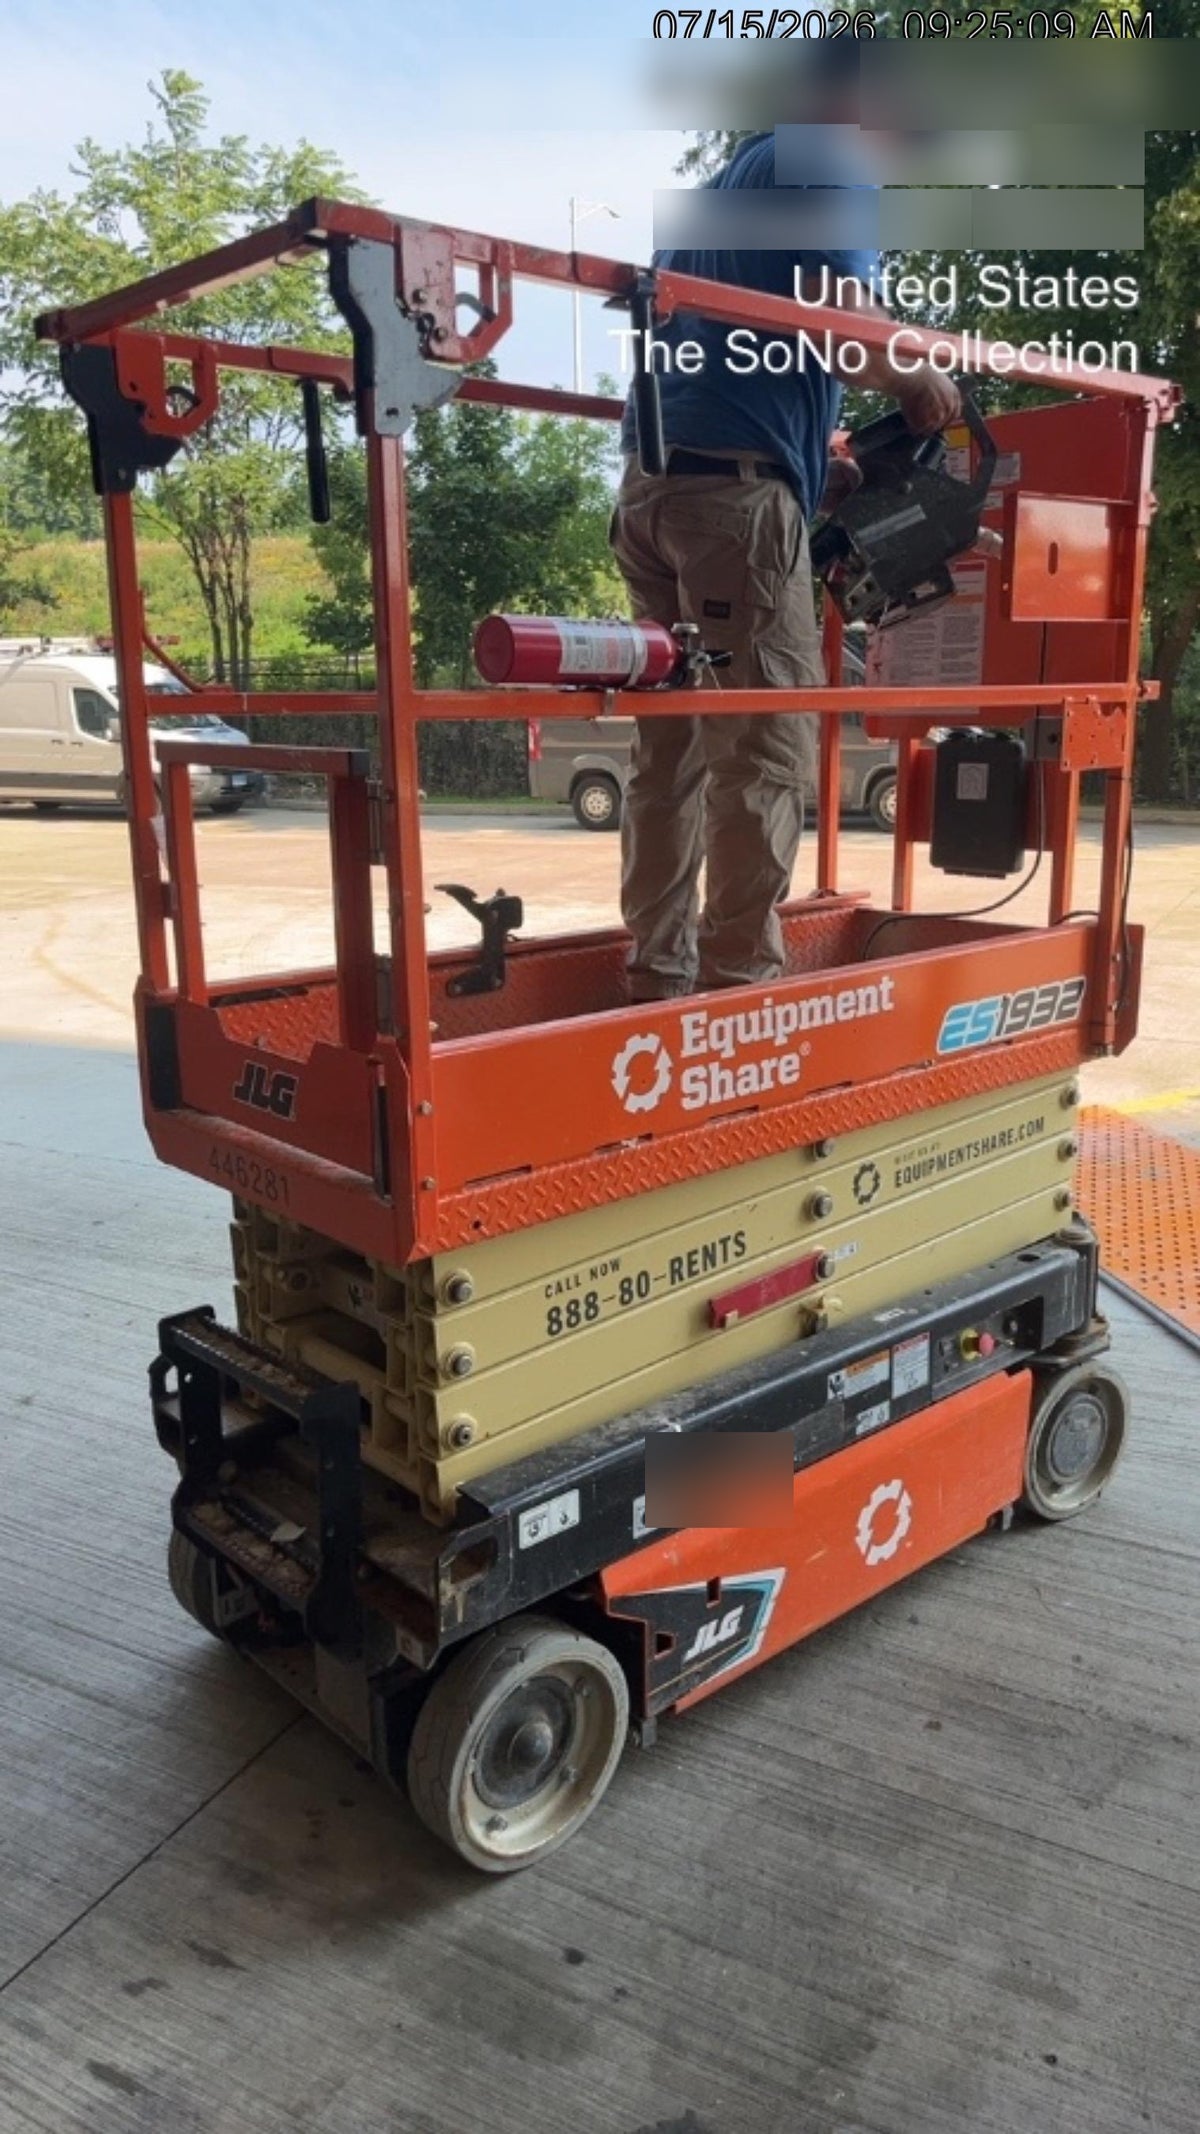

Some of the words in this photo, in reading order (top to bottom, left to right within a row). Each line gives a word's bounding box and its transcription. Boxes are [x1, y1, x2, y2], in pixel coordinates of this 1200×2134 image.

[681, 976, 895, 1057] Equipment
[938, 976, 1086, 1055] ES1932
[232, 1060, 298, 1121] JLG
[208, 1143, 291, 1207] 446281
[894, 1115, 1045, 1189] EQUIPMENTSHARE.COM
[544, 1274, 582, 1299] CALL
[589, 1257, 621, 1280] NOW
[546, 1230, 747, 1336] 888-80-RENTS
[684, 1605, 744, 1662] JLG
